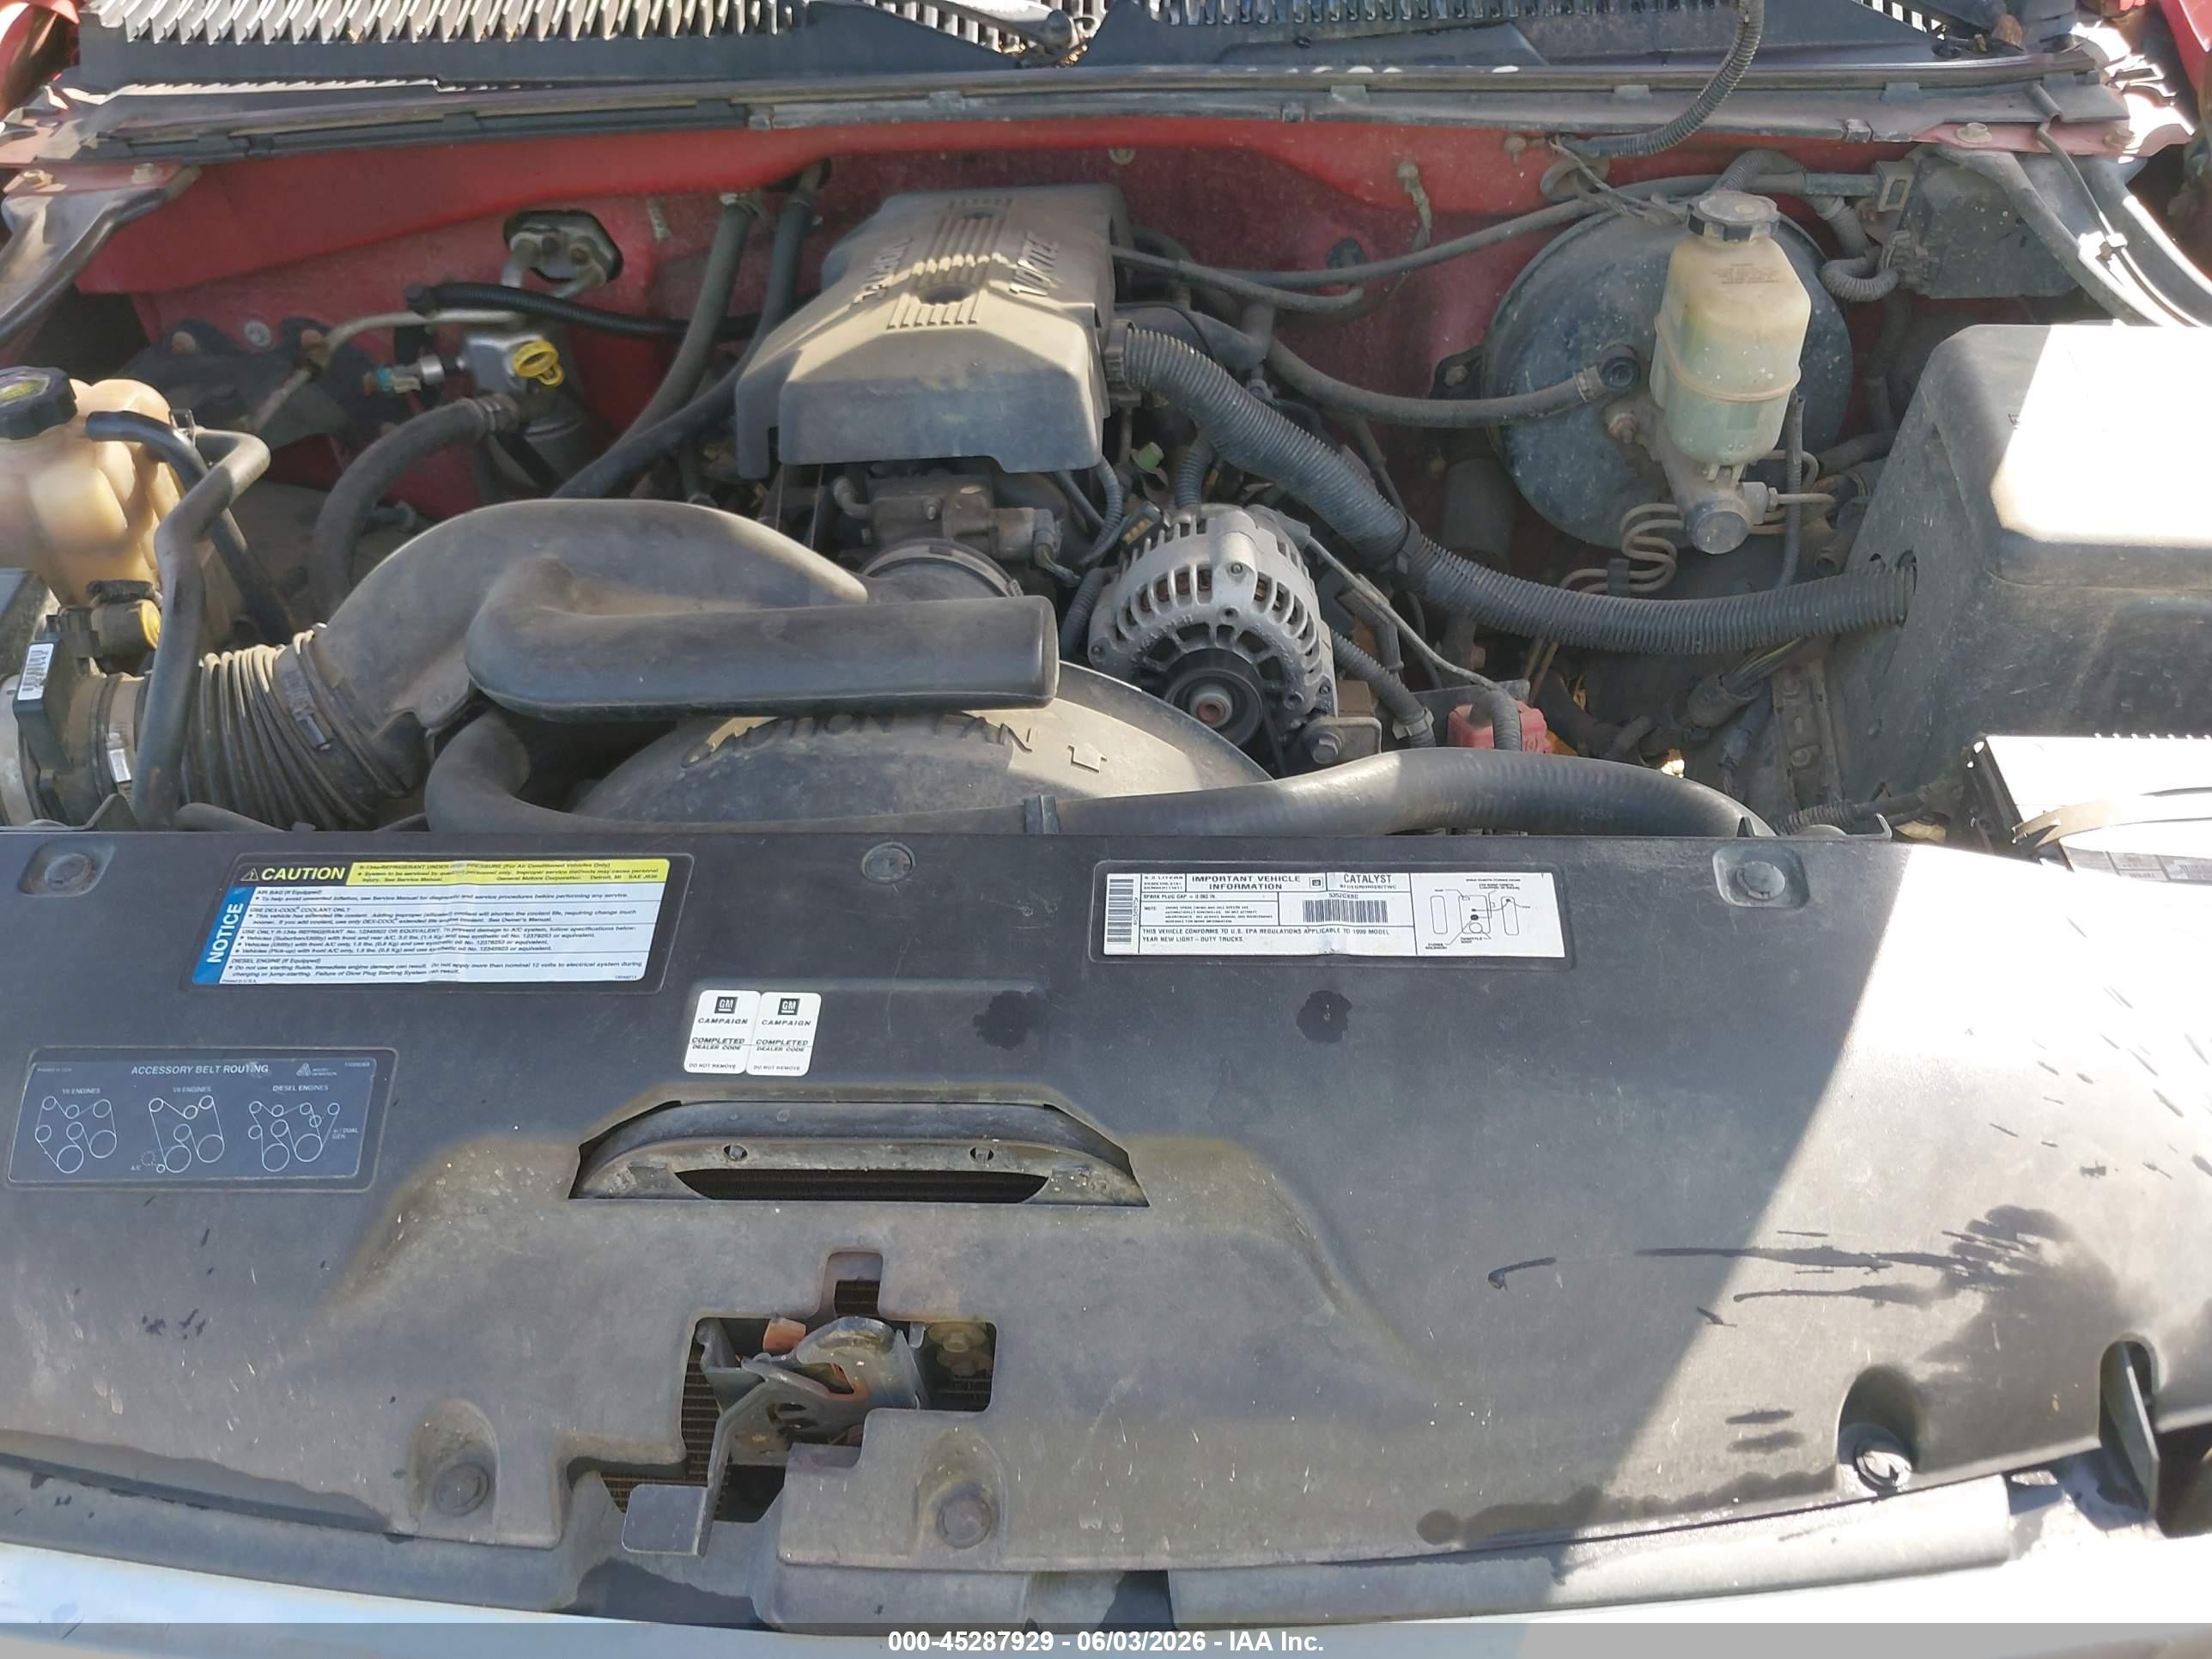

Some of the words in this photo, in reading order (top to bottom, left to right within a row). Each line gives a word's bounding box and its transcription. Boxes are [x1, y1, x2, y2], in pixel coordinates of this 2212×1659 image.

[261, 867, 345, 880] CAUTION
[1343, 874, 1392, 884] CATALYST
[206, 902, 244, 963] NOTICE
[719, 1000, 733, 1008] GM
[781, 1001, 797, 1010] GM
[131, 1066, 192, 1075] ACCESSORY
[196, 1065, 222, 1073] BELT
[223, 1064, 269, 1073] ROUTING
